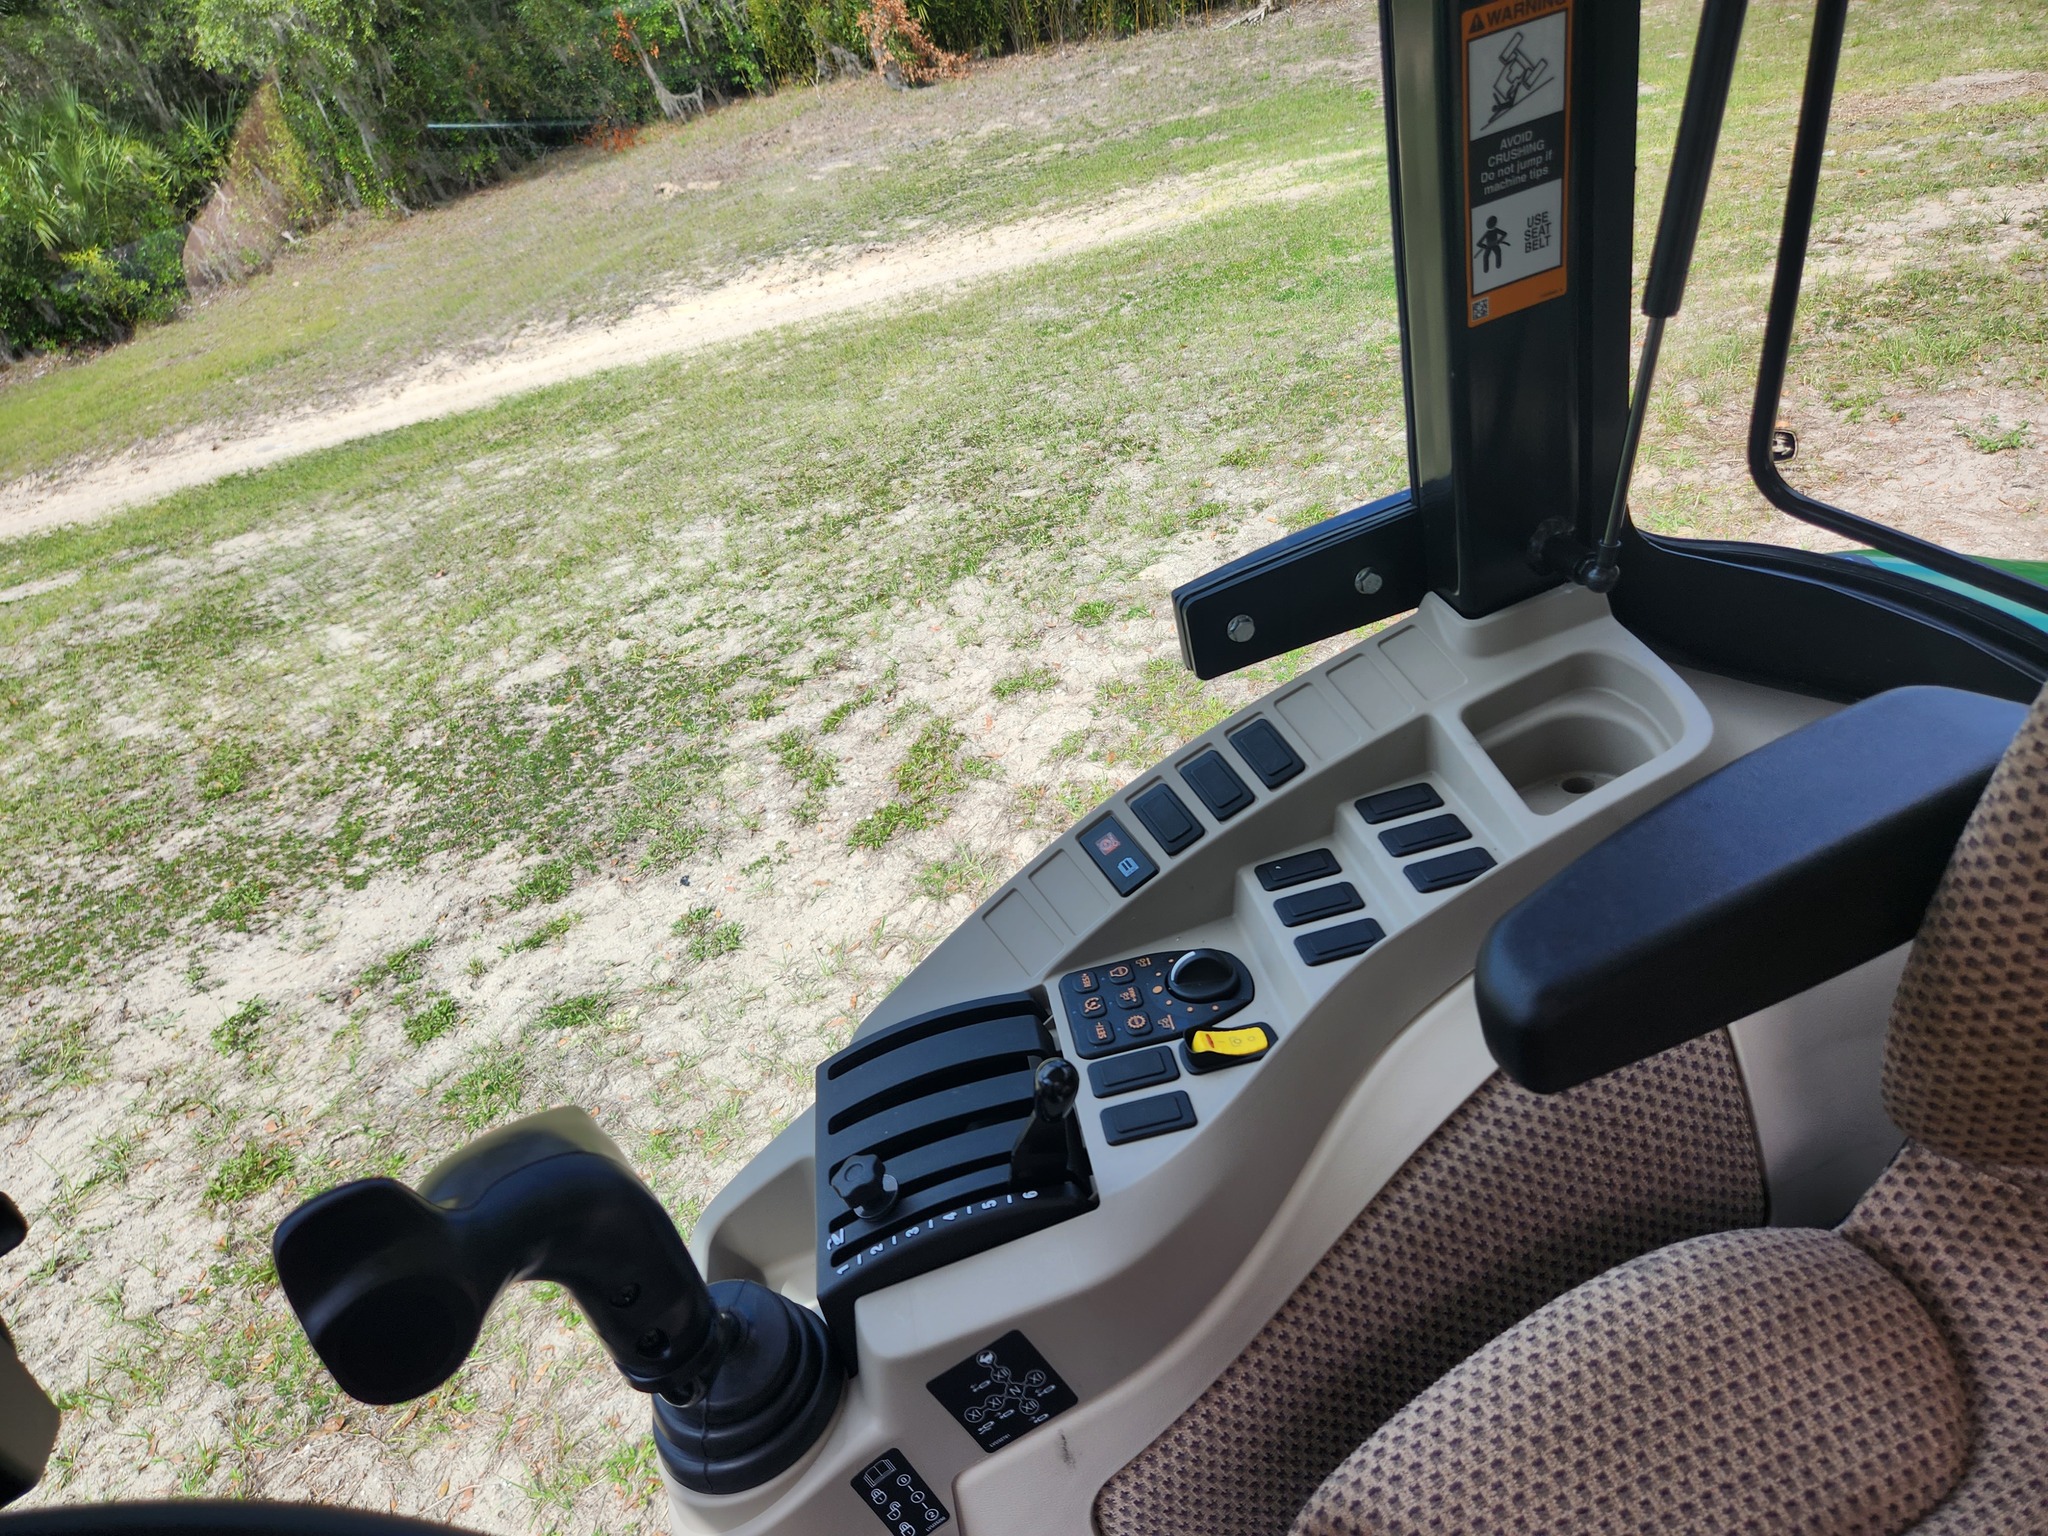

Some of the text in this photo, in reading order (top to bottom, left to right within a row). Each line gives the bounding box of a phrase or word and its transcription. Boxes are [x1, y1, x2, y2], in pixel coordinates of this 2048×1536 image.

[1500, 131, 1532, 150] AVOID
[1488, 140, 1545, 167] CRUSHING
[1481, 149, 1553, 183] Do not jump if
[1484, 166, 1549, 195] machine tips
[1527, 211, 1549, 228] USE
[1524, 222, 1552, 242] SEAT
[1524, 235, 1552, 254] BELT
[1022, 1190, 1039, 1199] 6
[981, 1199, 998, 1210] 5
[942, 1211, 958, 1222] 4
[905, 1226, 920, 1238] 3
[870, 1243, 884, 1255] 2
[836, 1264, 850, 1275] 1
[1009, 1385, 1021, 1396] N
